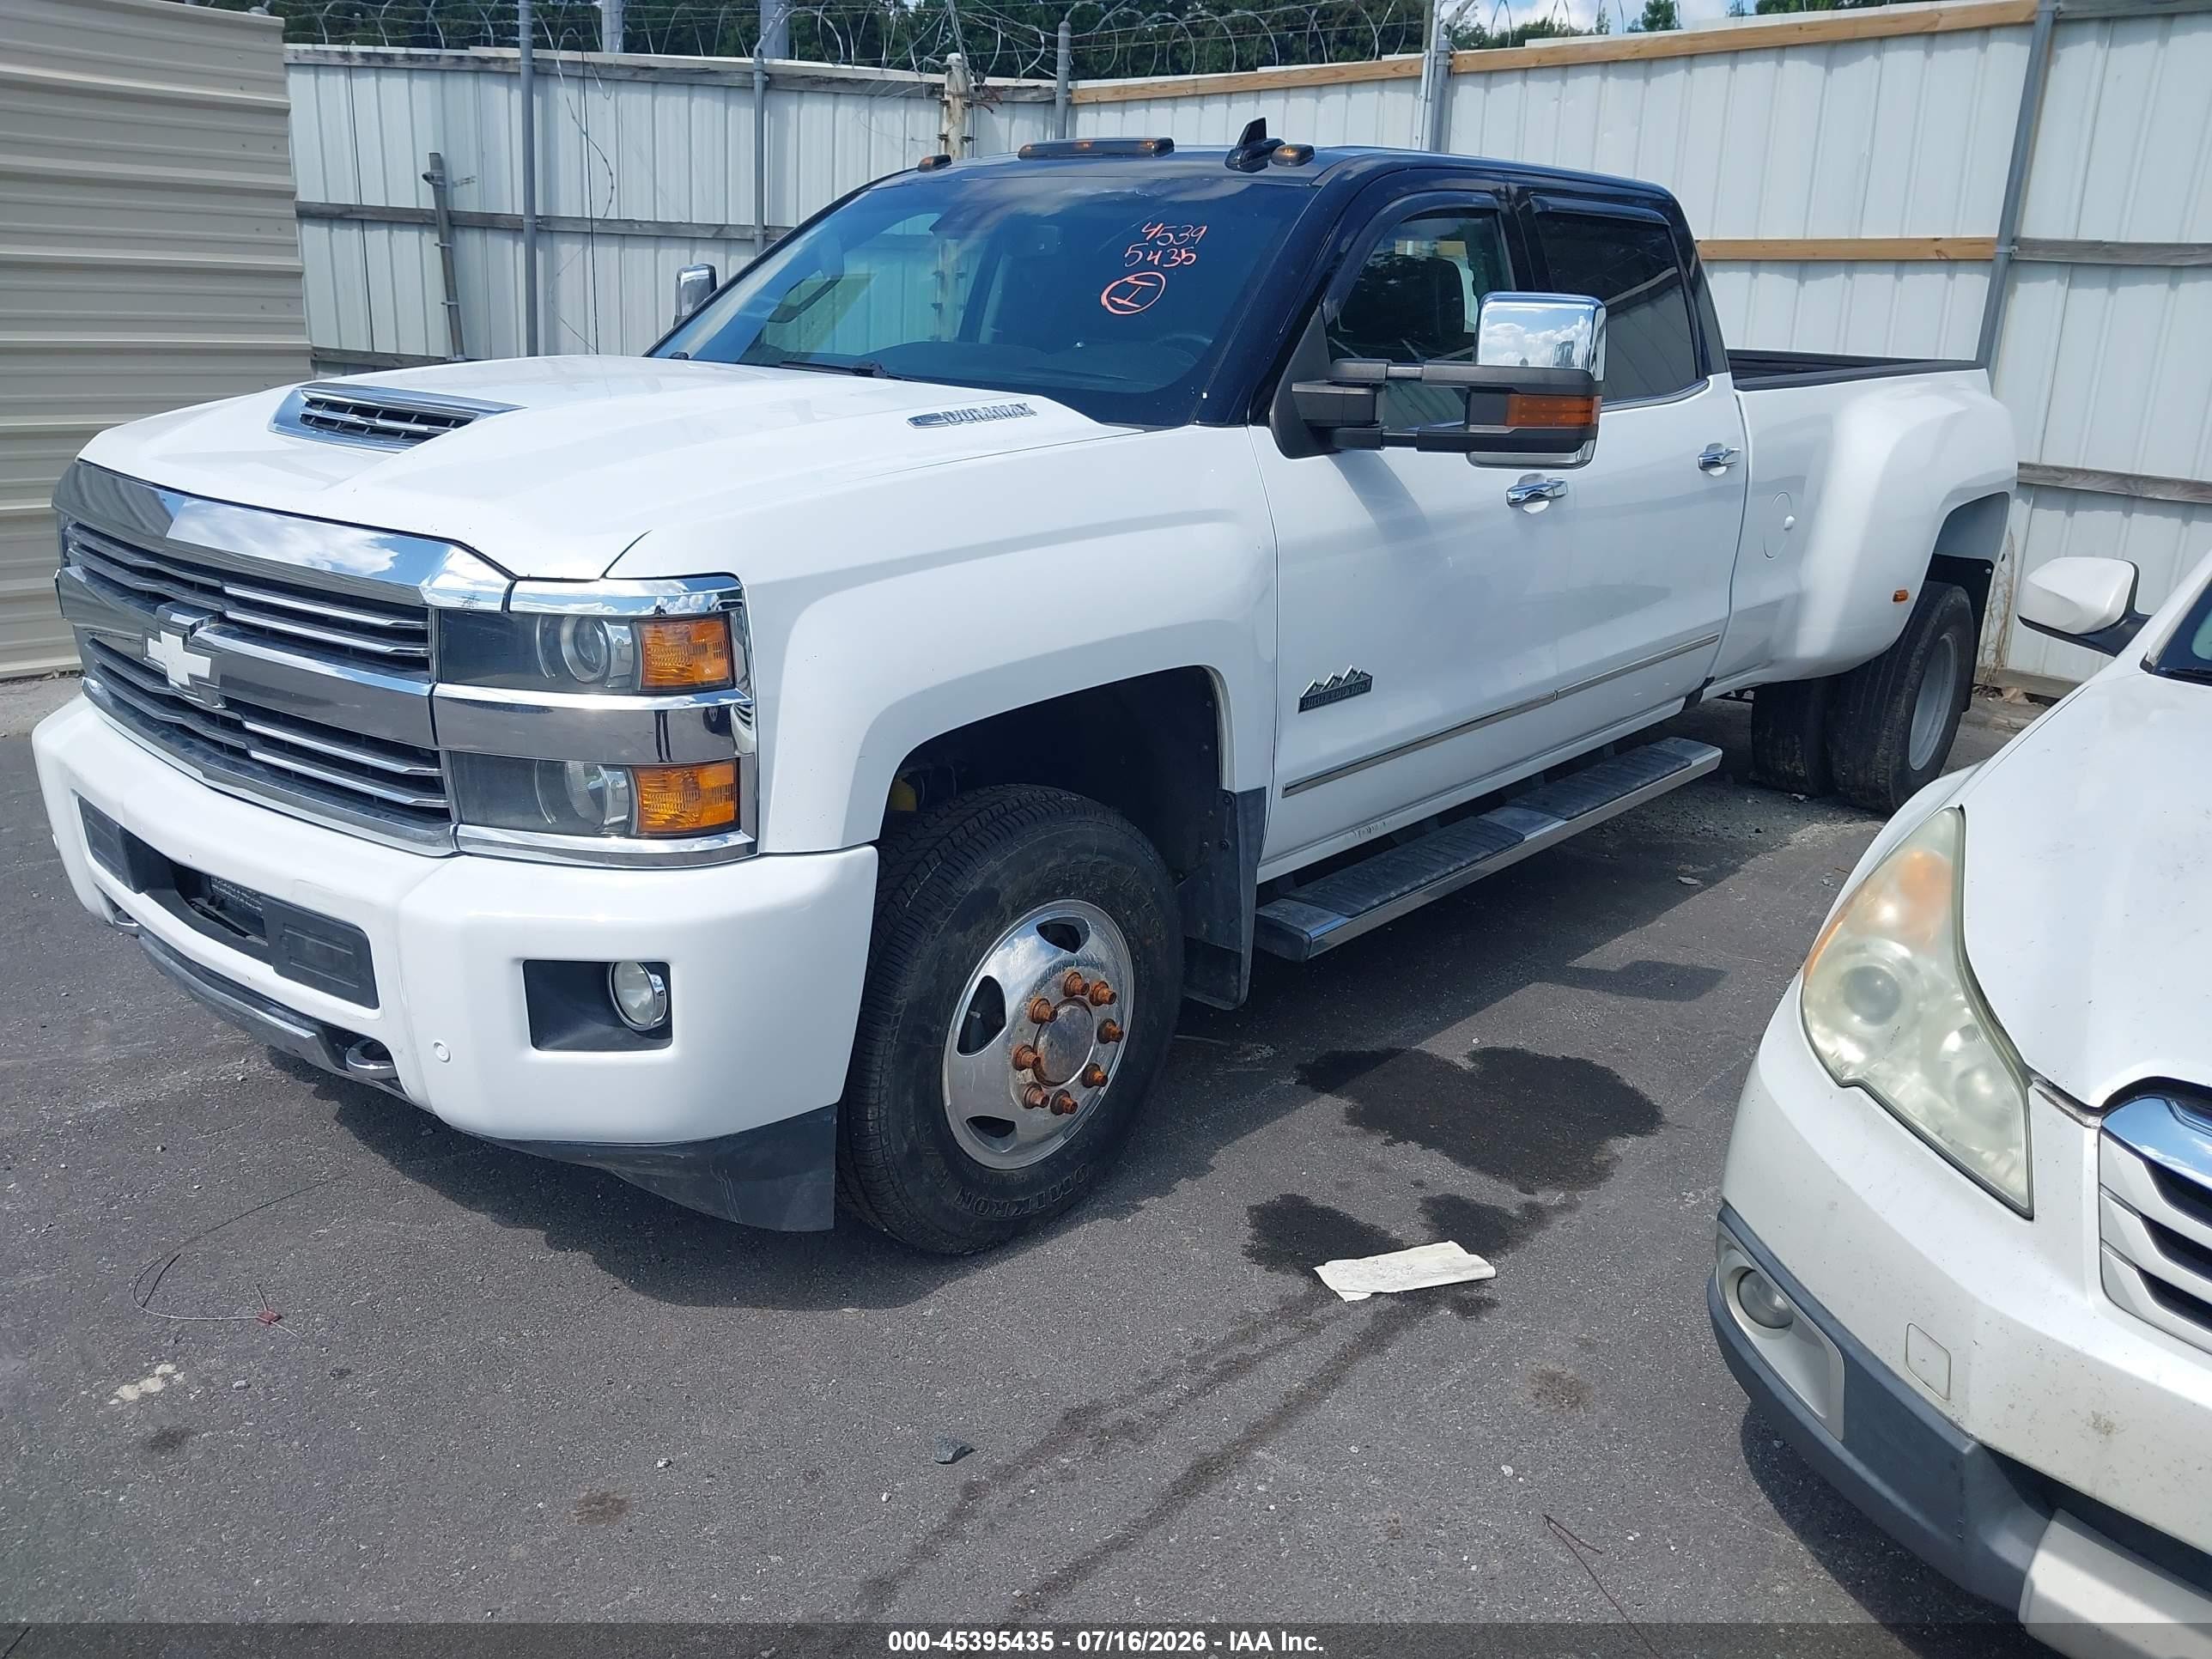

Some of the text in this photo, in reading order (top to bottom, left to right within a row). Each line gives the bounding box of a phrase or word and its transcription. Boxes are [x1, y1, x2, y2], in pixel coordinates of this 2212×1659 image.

[1141, 222, 1208, 246] 4539
[1124, 243, 1197, 268] 5435
[941, 403, 1037, 426] DURAMAX
